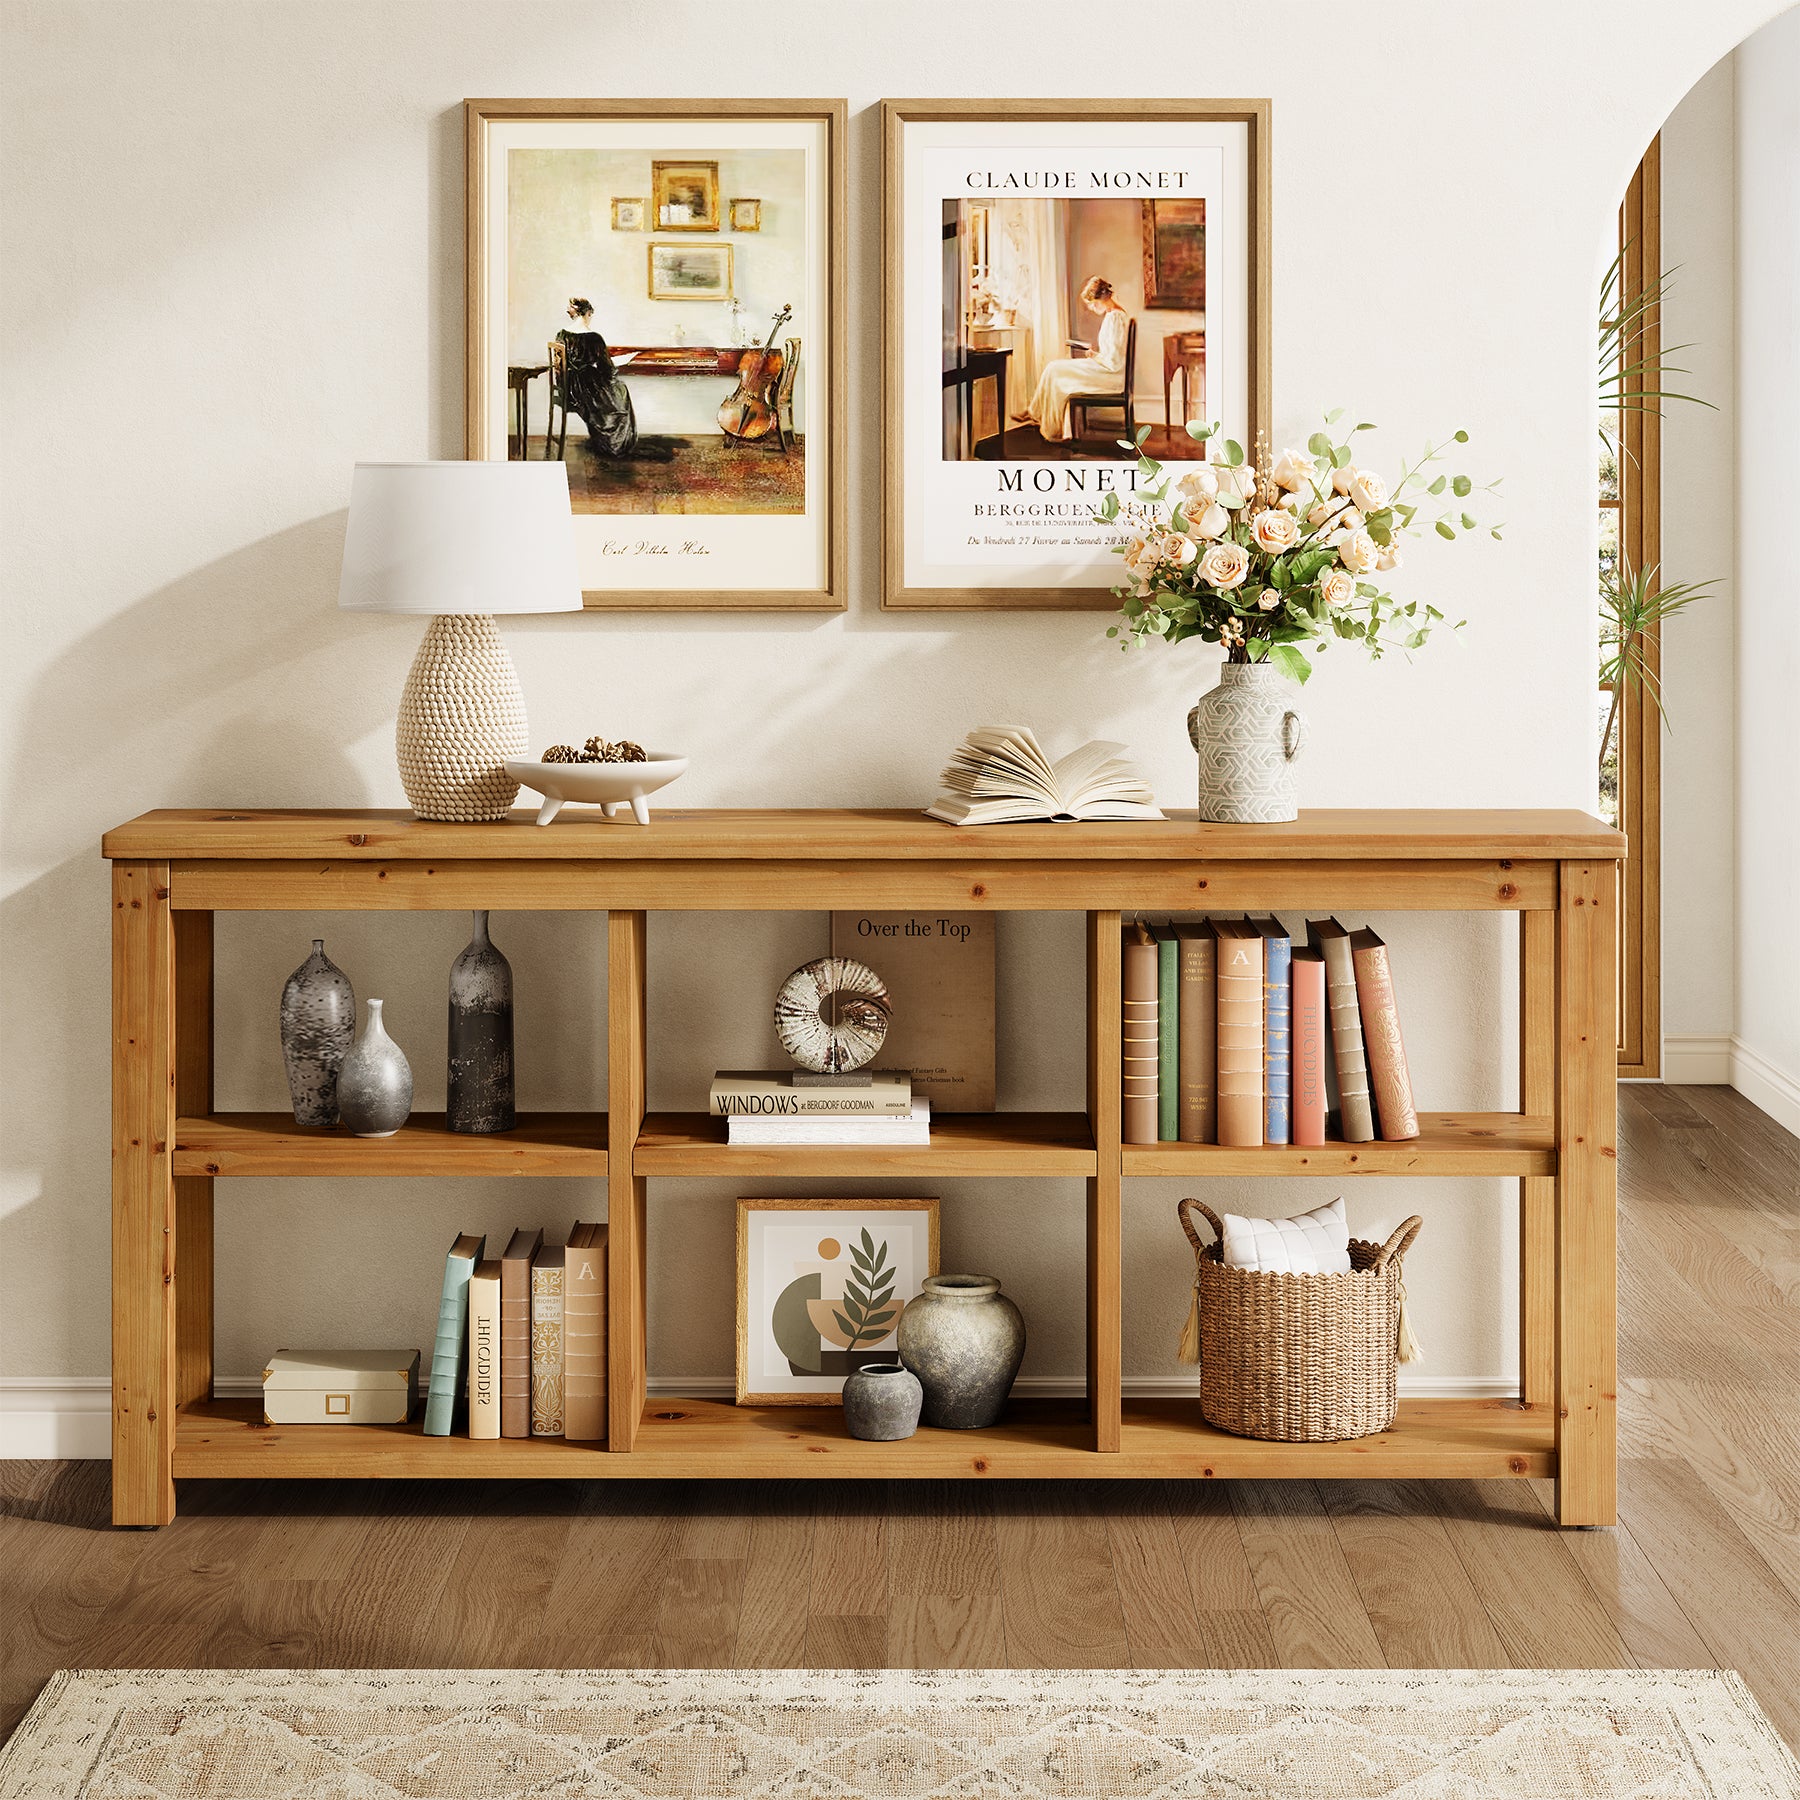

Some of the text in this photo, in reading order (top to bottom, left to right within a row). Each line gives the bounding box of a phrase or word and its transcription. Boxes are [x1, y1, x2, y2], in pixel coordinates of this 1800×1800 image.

[966, 171, 1189, 188] CLAUDE MONET
[997, 468, 1140, 492] MONET
[974, 503, 1097, 516] BERGGRUEN
[857, 918, 971, 943] Over the Top
[1231, 950, 1250, 965] A
[1303, 1000, 1318, 1107] THUCYDIDES
[716, 1095, 798, 1114] WINDOWS
[807, 1100, 839, 1110] BERGDORF
[840, 1100, 875, 1110] GOODMAN
[576, 1262, 596, 1280] A
